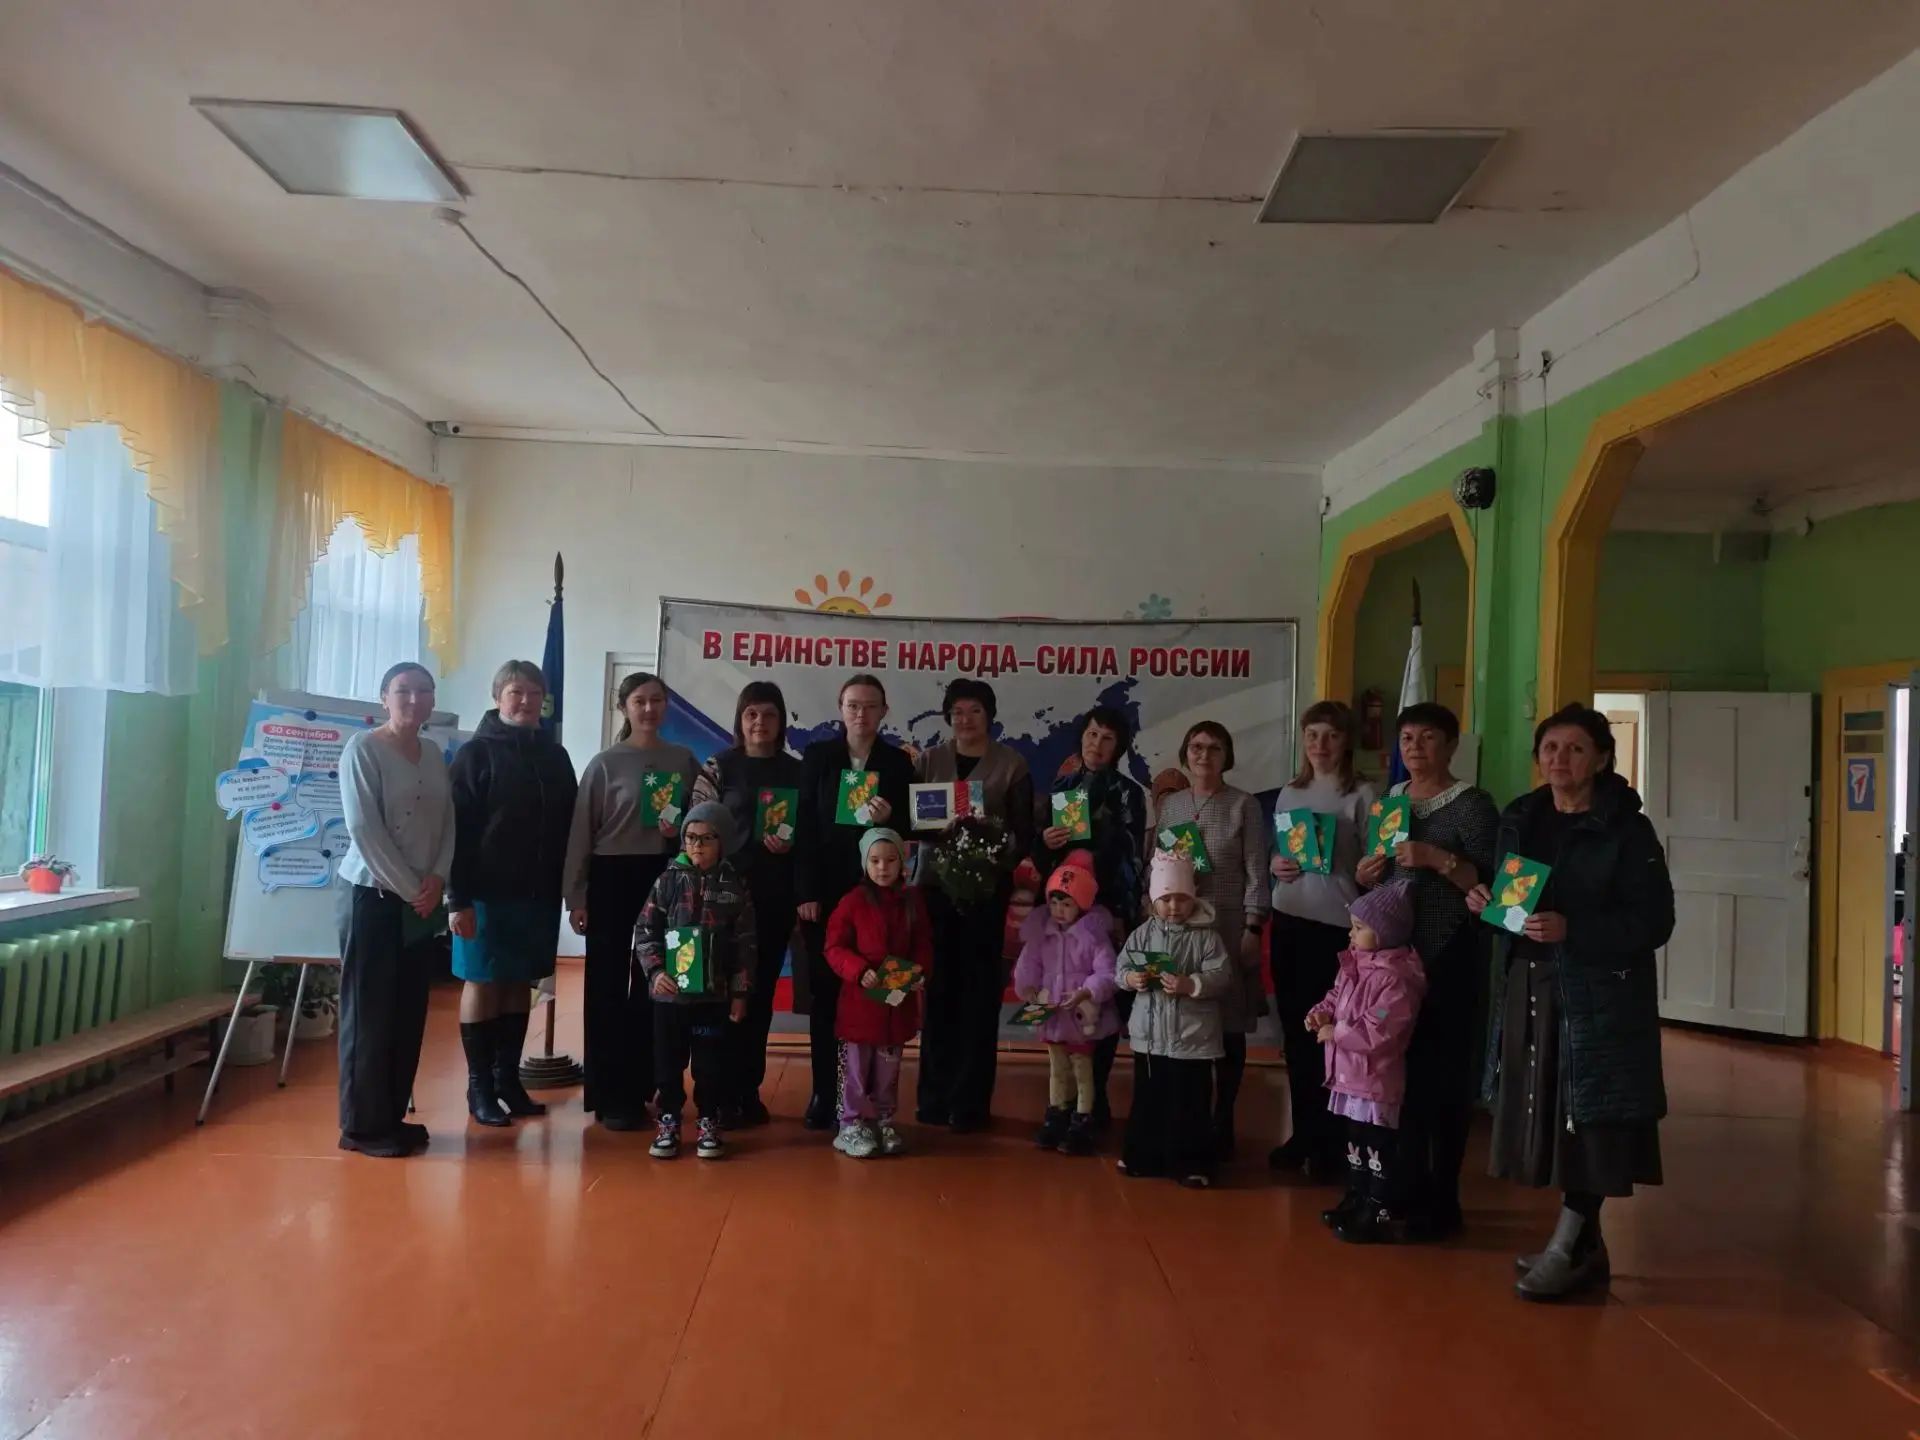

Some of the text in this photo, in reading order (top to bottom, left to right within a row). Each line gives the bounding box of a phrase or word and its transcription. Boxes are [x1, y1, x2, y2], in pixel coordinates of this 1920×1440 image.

[702, 631, 722, 660] В
[732, 632, 888, 668] ЕДИНСТВЕ
[1130, 647, 1250, 678] РОССИИ
[286, 728, 333, 740] сентября
